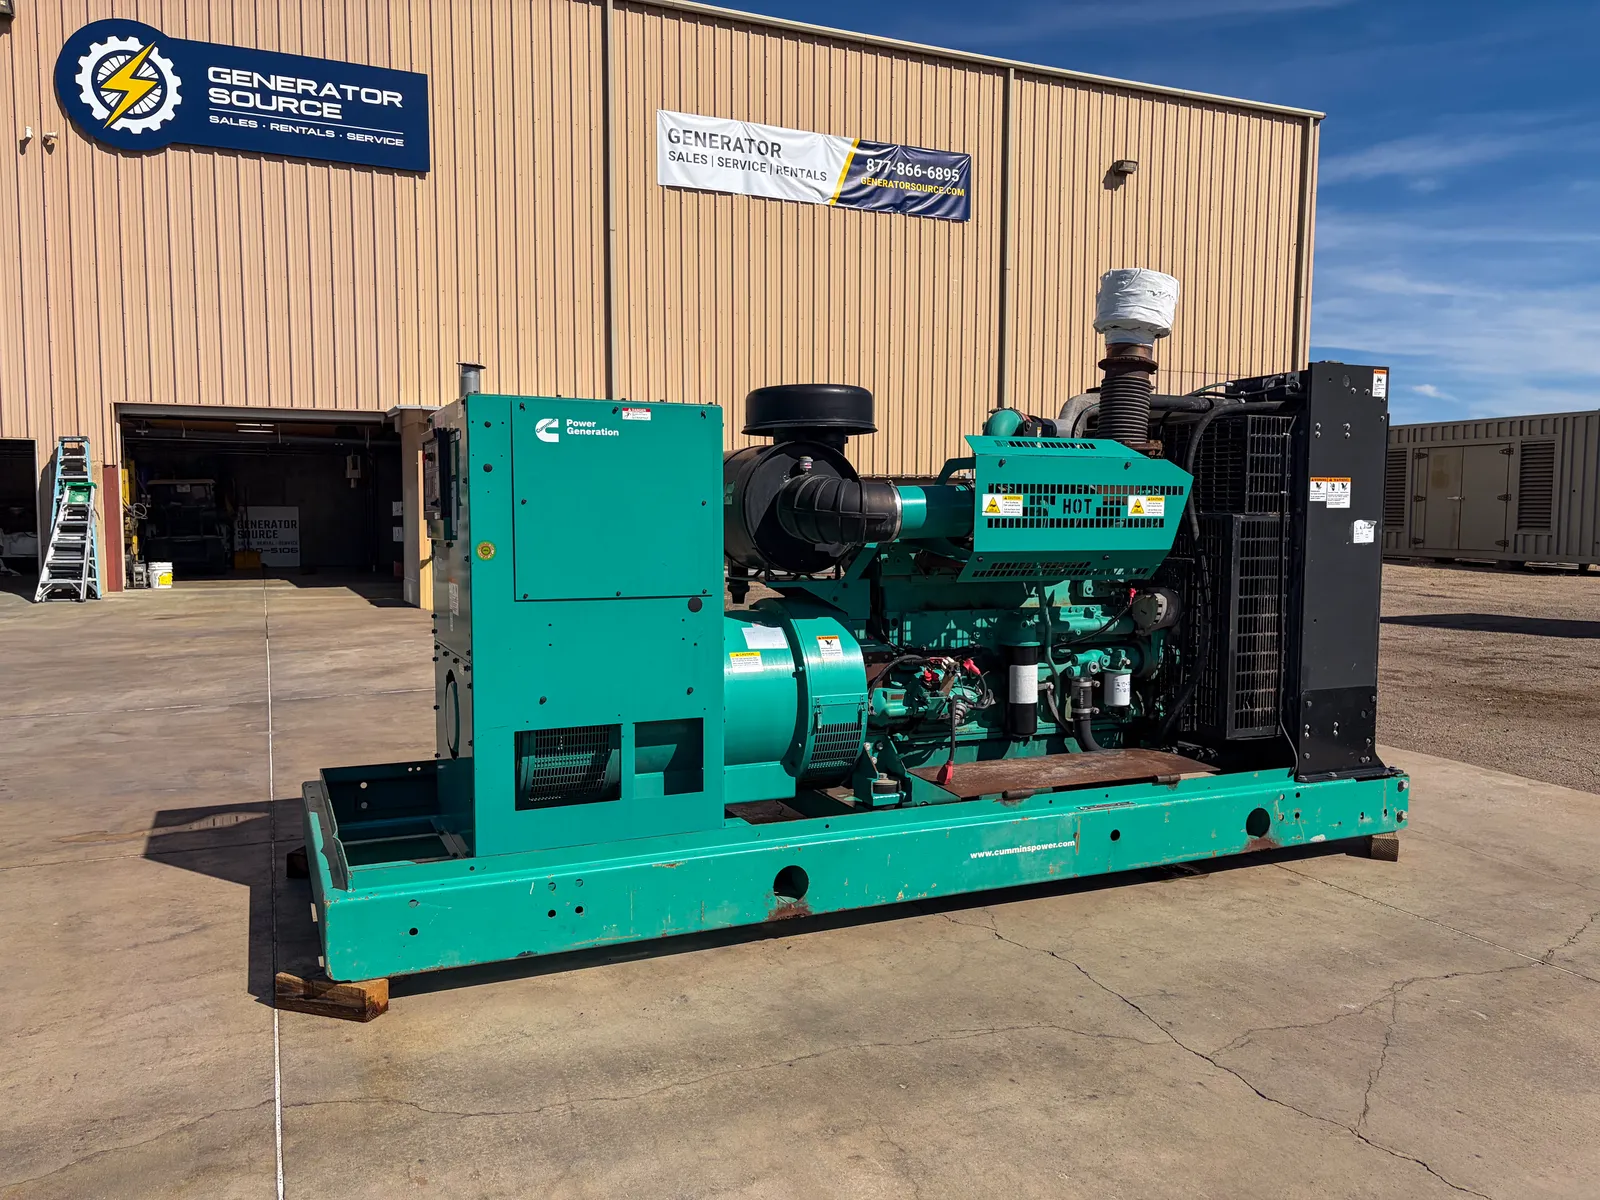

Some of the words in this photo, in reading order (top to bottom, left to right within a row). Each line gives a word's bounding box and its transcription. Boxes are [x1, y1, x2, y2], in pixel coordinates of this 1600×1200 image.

[207, 66, 403, 108] GENERATOR
[208, 87, 343, 120] SOURCE
[209, 115, 258, 128] SALES
[270, 123, 335, 138] RENTALS
[347, 132, 404, 147] SERVICE
[667, 127, 782, 159] GENERATOR
[668, 150, 708, 166] SALES
[717, 158, 767, 173] SERVICE
[776, 164, 827, 182] RENTALS
[866, 158, 960, 183] 877-866-6895
[860, 176, 965, 197] GENERATORSOURCE.COM
[566, 419, 596, 427] Power
[566, 427, 619, 436] Generation
[1063, 498, 1093, 515] HOT
[237, 520, 297, 529] GENERATOR
[238, 530, 278, 539] SOURCE
[970, 839, 1076, 859] www.cumminspower.com
